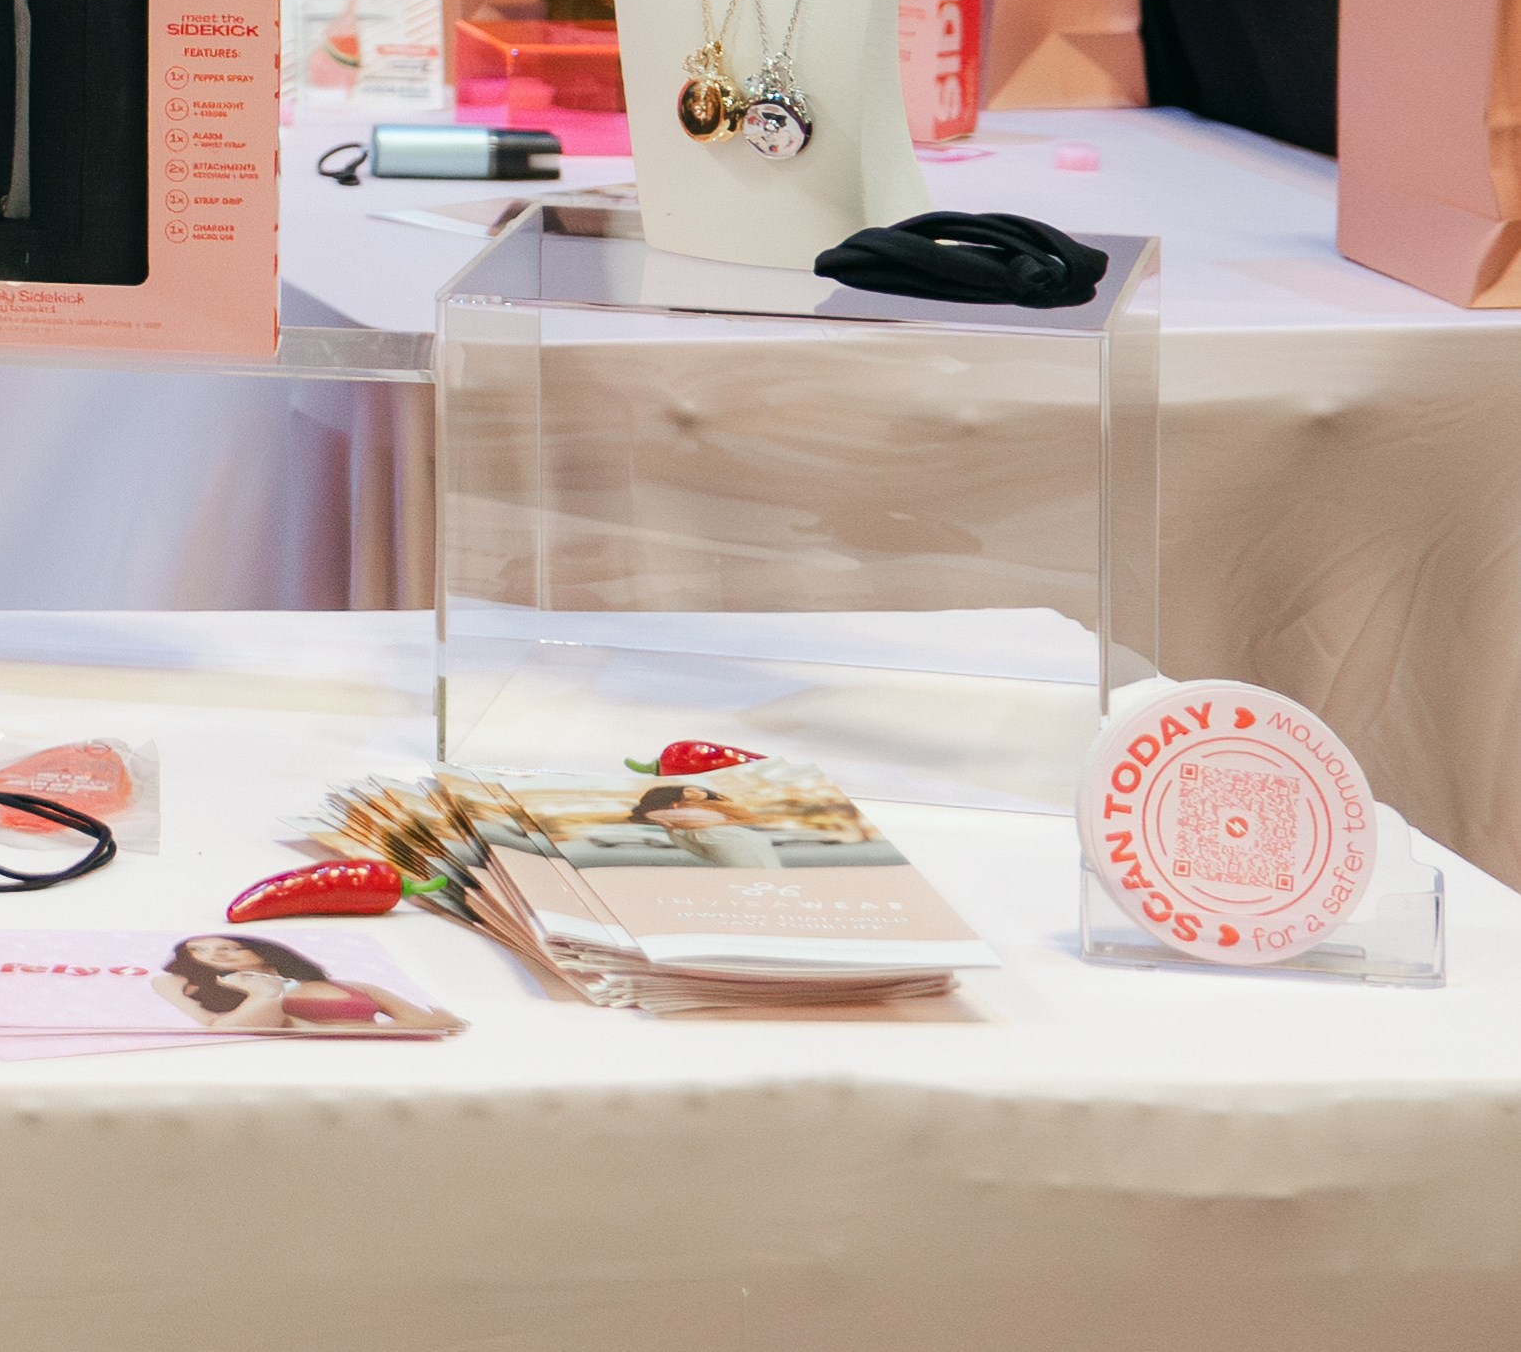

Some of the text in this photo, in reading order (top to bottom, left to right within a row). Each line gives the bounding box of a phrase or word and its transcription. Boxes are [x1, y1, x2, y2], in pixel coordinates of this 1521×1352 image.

[181, 13, 245, 24] meet the
[166, 23, 260, 37] SIDEKICK
[183, 47, 242, 58] FEATURES:
[18, 289, 86, 305] Sidekick
[1103, 701, 1213, 942] SCAN TODAY
[1251, 711, 1366, 952] for a safer tomorrow
